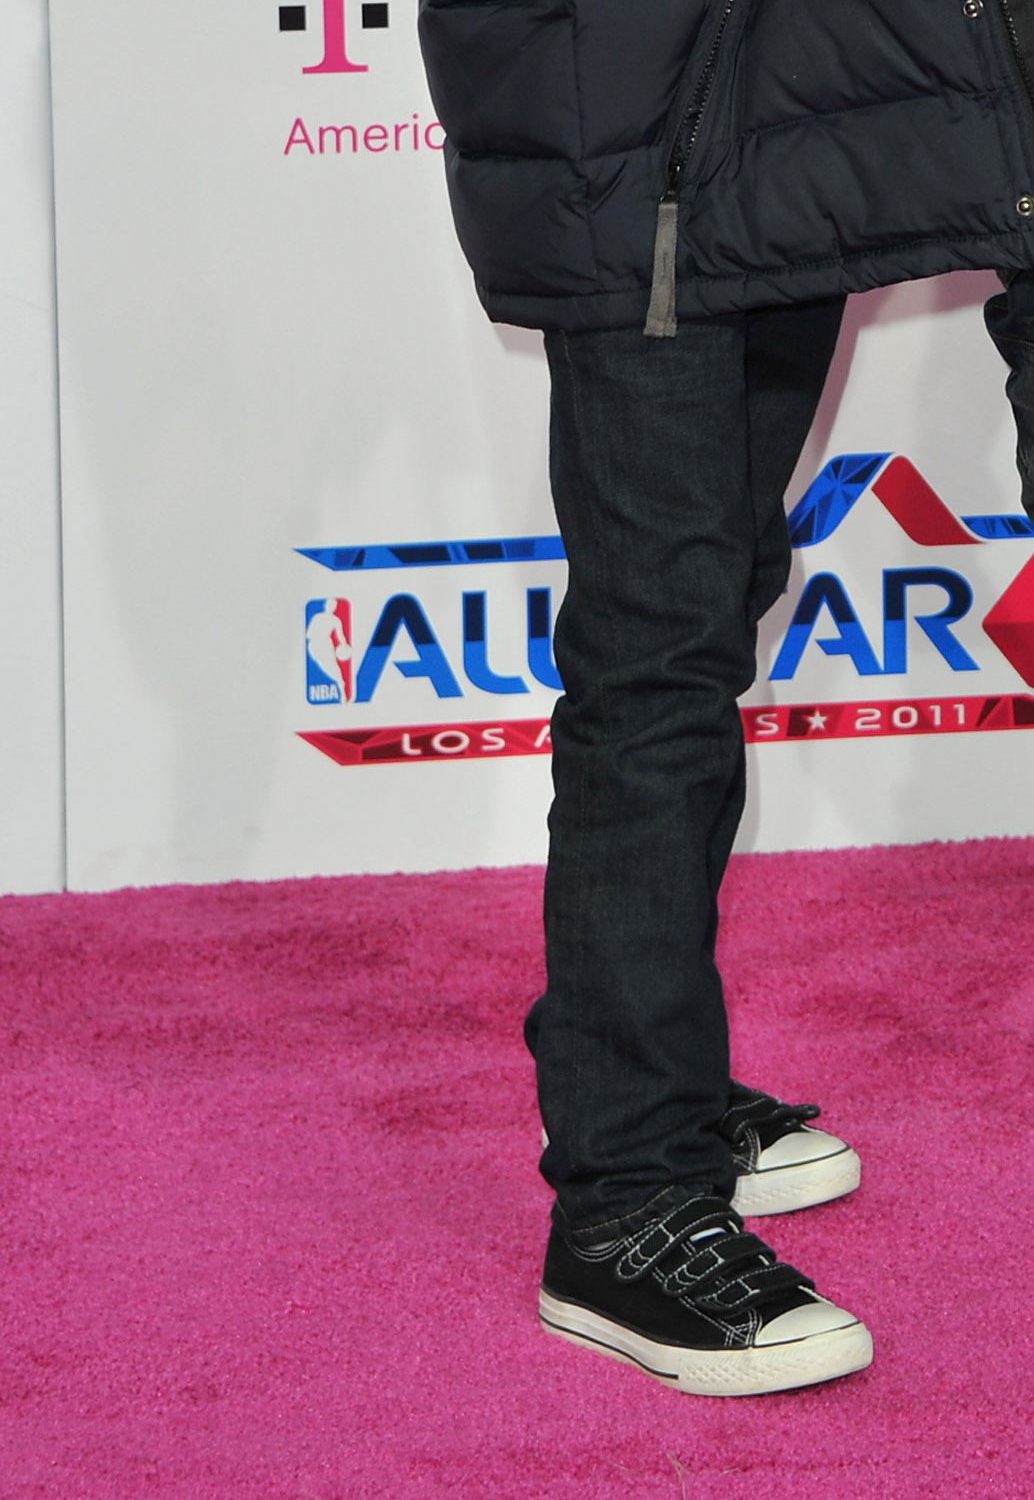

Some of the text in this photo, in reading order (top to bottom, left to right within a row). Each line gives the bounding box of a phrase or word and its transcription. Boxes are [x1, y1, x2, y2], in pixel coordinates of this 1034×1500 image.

[283, 113, 444, 155] Americ
[767, 565, 981, 681] AR
[310, 683, 340, 702] NBA
[854, 703, 966, 731] 2011
[401, 727, 506, 756] LOS
